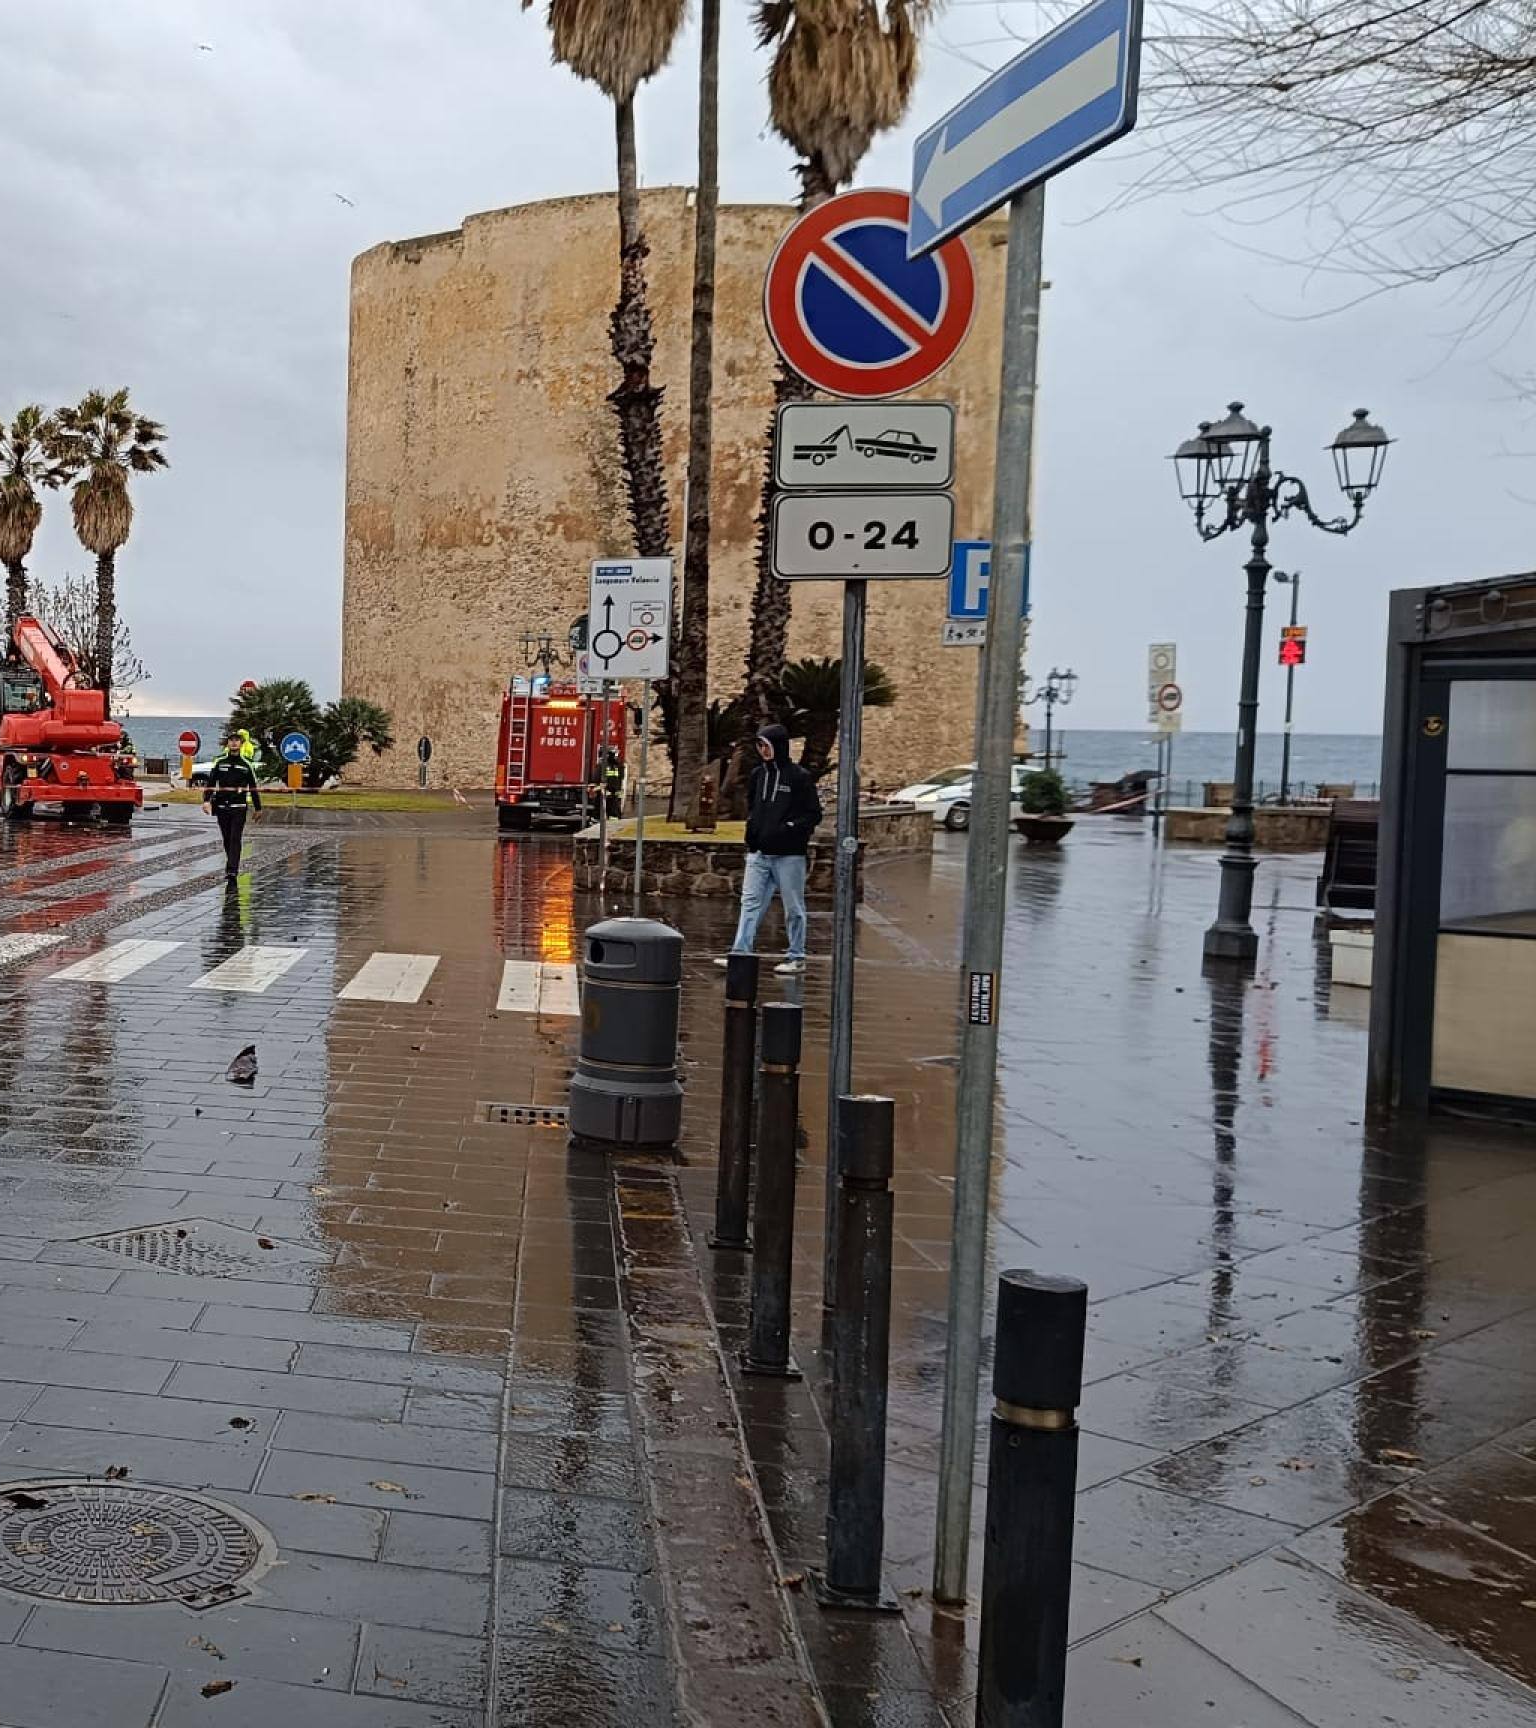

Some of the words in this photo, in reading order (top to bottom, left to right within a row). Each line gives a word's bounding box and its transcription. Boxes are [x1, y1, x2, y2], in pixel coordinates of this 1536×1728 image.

[541, 716, 577, 726] VIGILI
[547, 727, 570, 736] DEL
[540, 738, 577, 747] FUOCO
